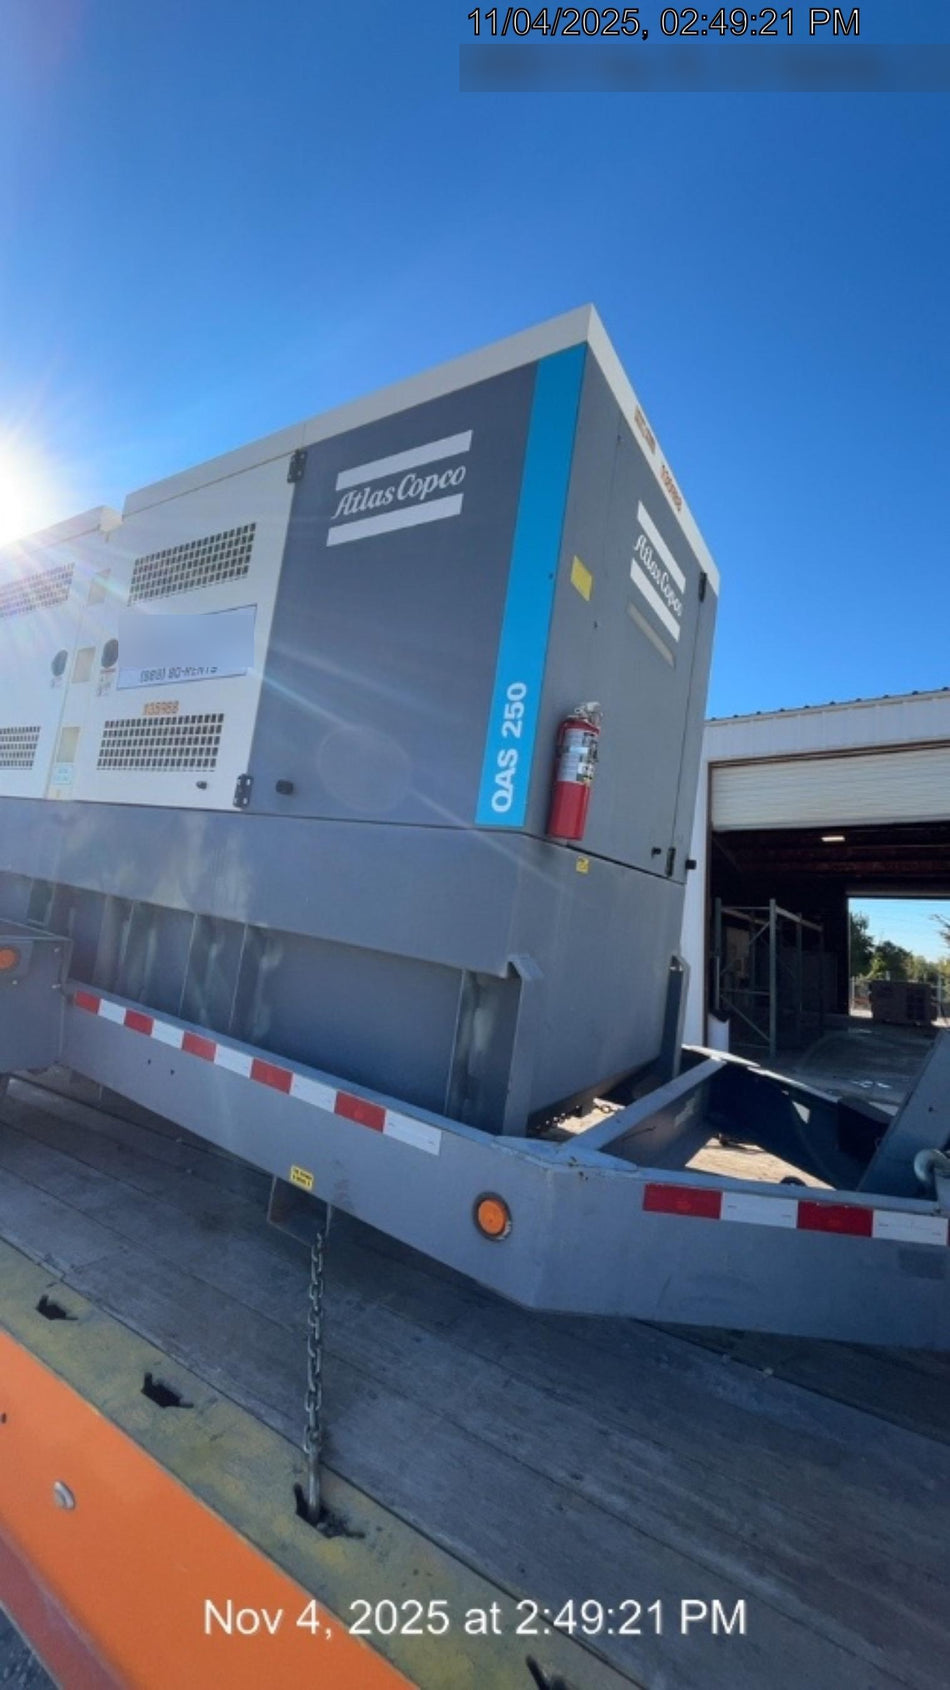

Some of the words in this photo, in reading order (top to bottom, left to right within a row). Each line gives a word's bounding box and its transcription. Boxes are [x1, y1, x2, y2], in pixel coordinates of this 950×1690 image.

[330, 484, 396, 519] Atlas
[396, 465, 467, 500] Copco
[633, 534, 661, 586] Atlas
[660, 572, 683, 617] Copco
[502, 682, 527, 738] 250
[491, 748, 518, 813] QAS
